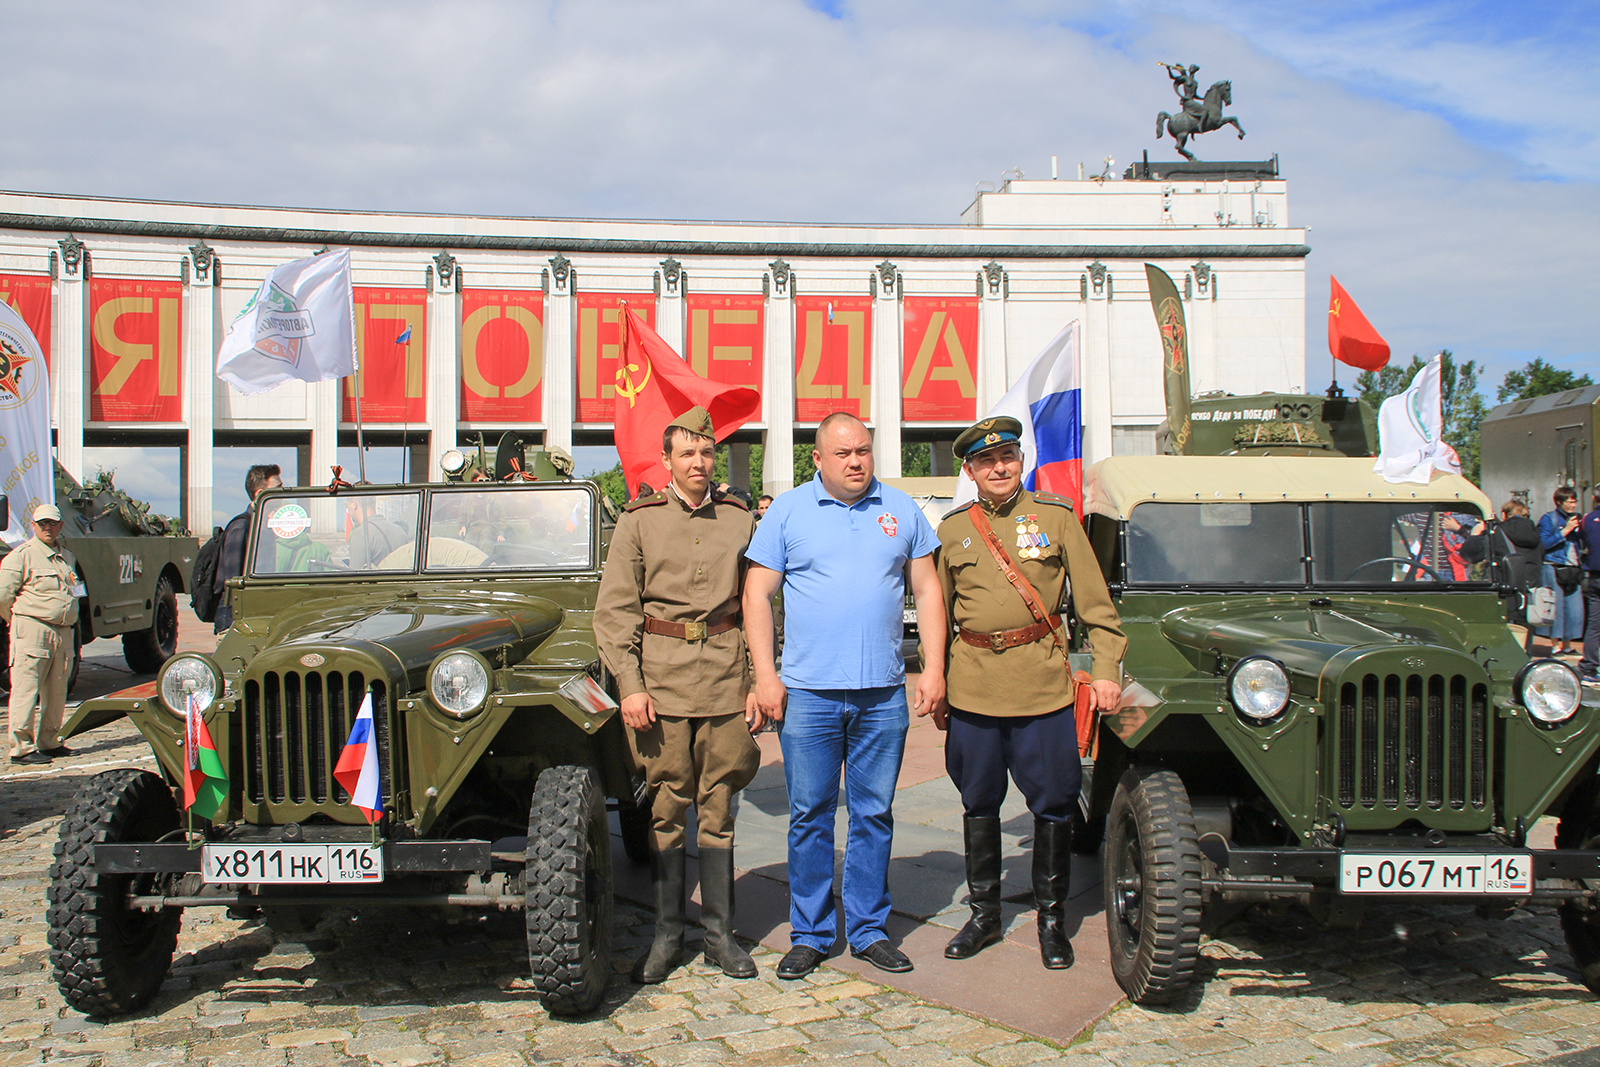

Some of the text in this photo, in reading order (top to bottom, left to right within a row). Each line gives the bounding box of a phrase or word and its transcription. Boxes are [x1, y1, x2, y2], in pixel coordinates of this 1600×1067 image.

[119, 554, 134, 584] 221
[331, 848, 373, 870] 116
[1490, 858, 1519, 880] 16
[340, 870, 361, 878] RUS
[1487, 880, 1509, 888] RUS
